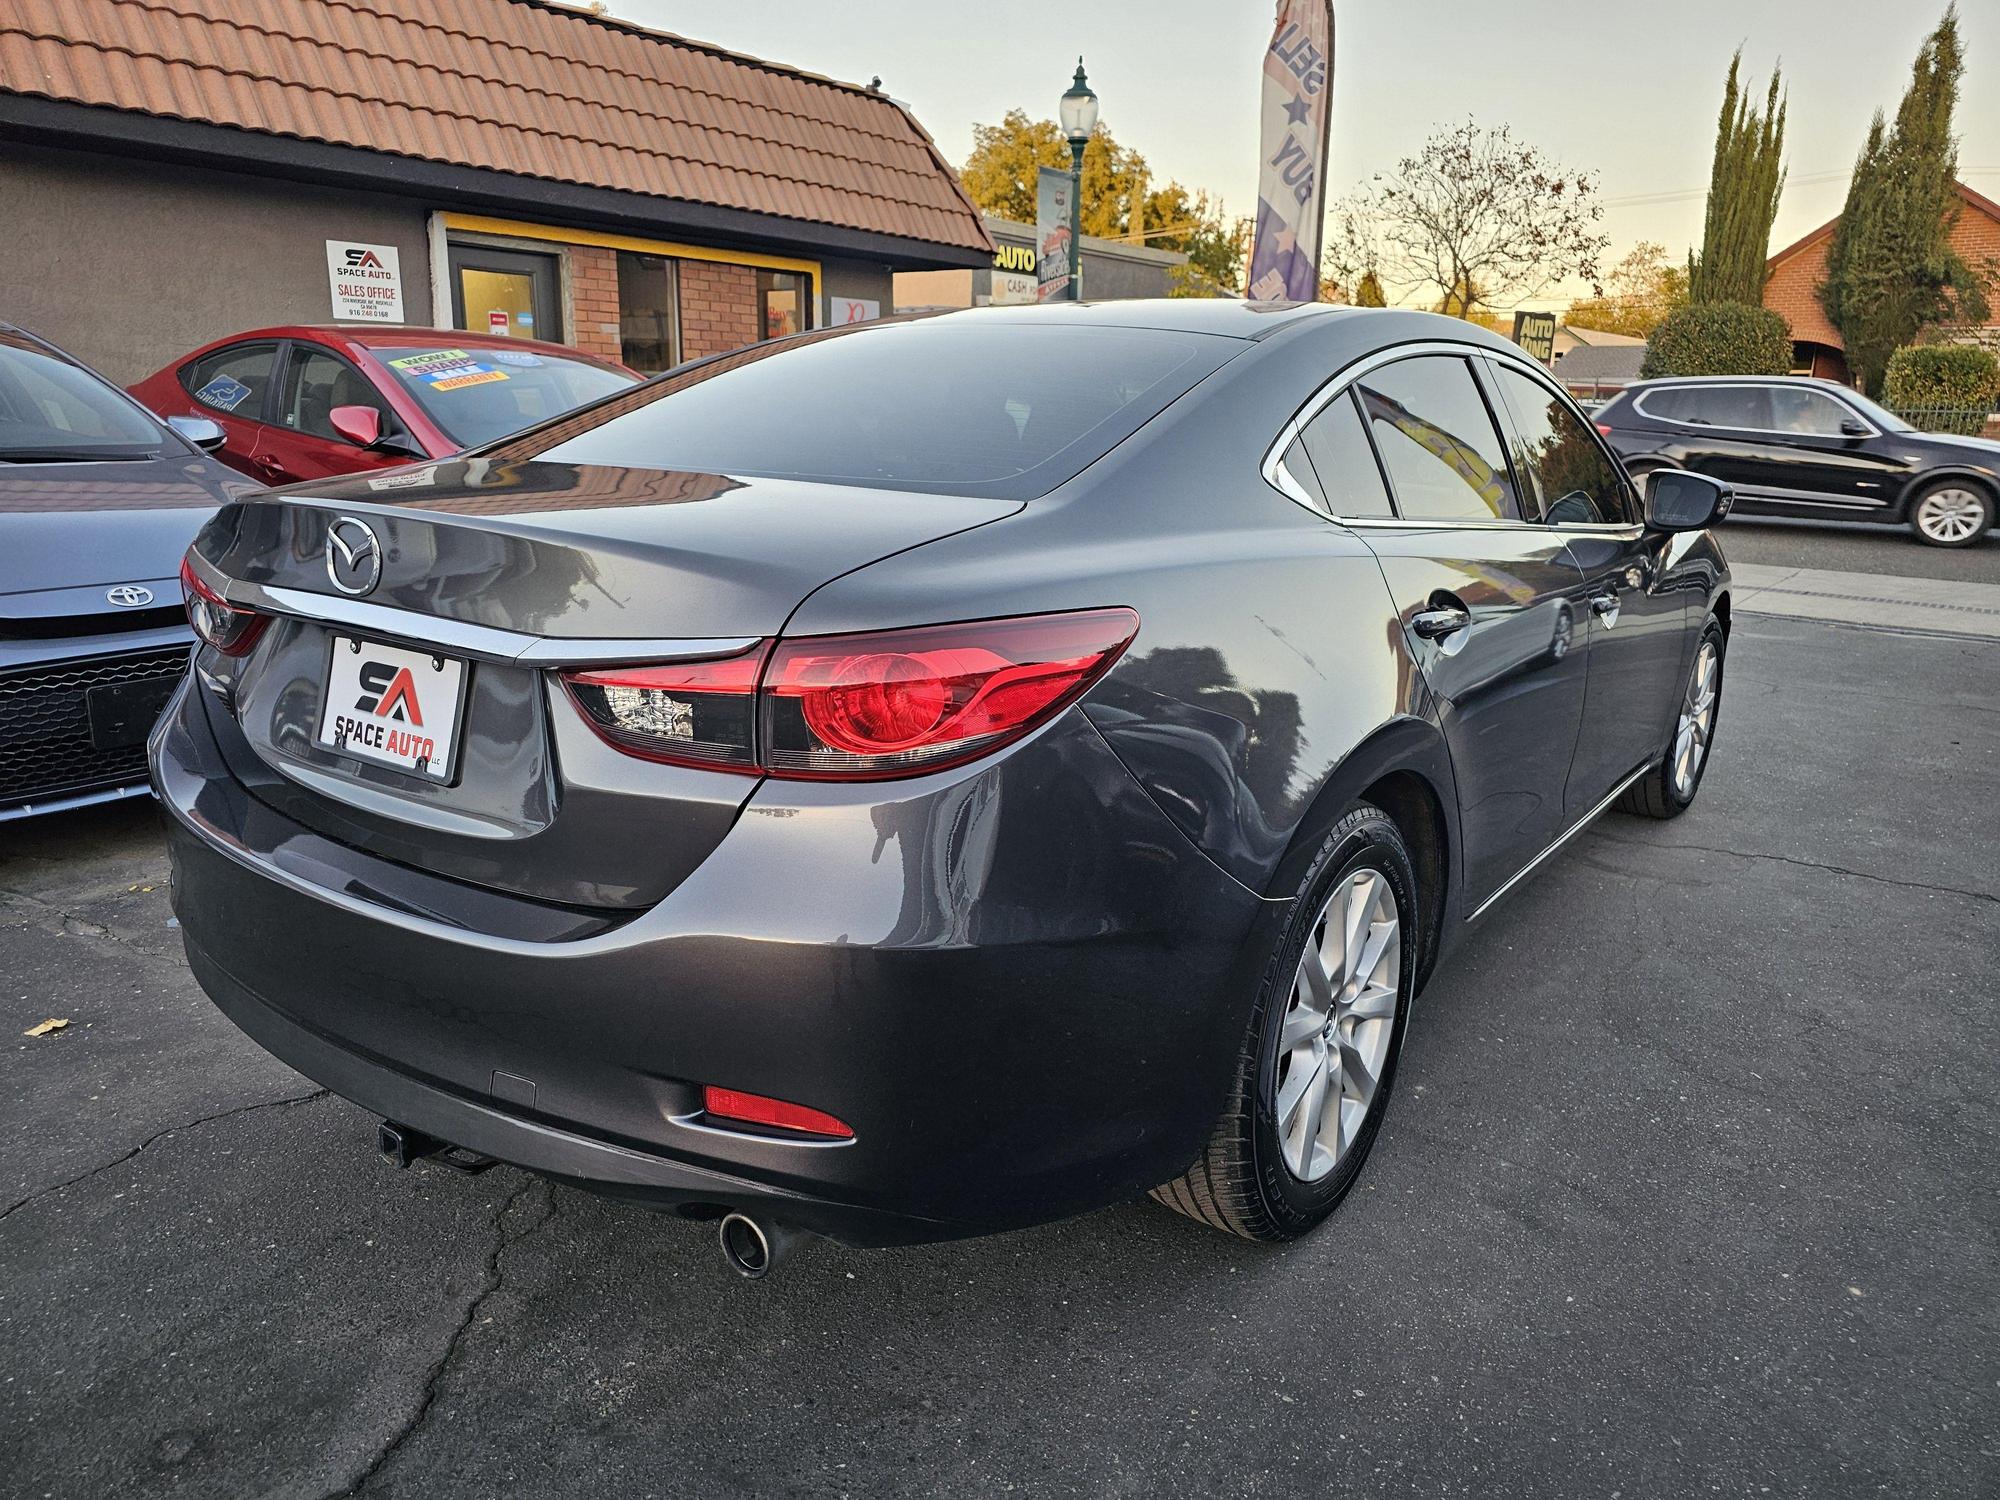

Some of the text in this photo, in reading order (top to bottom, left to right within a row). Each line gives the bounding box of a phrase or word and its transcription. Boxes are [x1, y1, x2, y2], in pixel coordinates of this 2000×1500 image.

[345, 249, 384, 269] SA
[994, 245, 1036, 272] AUTO
[337, 268, 366, 277] SPACE
[368, 271, 392, 280] AUTO
[338, 284, 396, 300] SALES OFFICE
[1007, 279, 1026, 294] CASH
[1520, 315, 1554, 338] AUTO
[1520, 337, 1551, 359] KING
[402, 353, 447, 367] WOW
[443, 373, 501, 388] WARRANTY
[354, 661, 424, 727] SA
[335, 715, 440, 766] SPACE AUTO LLC
